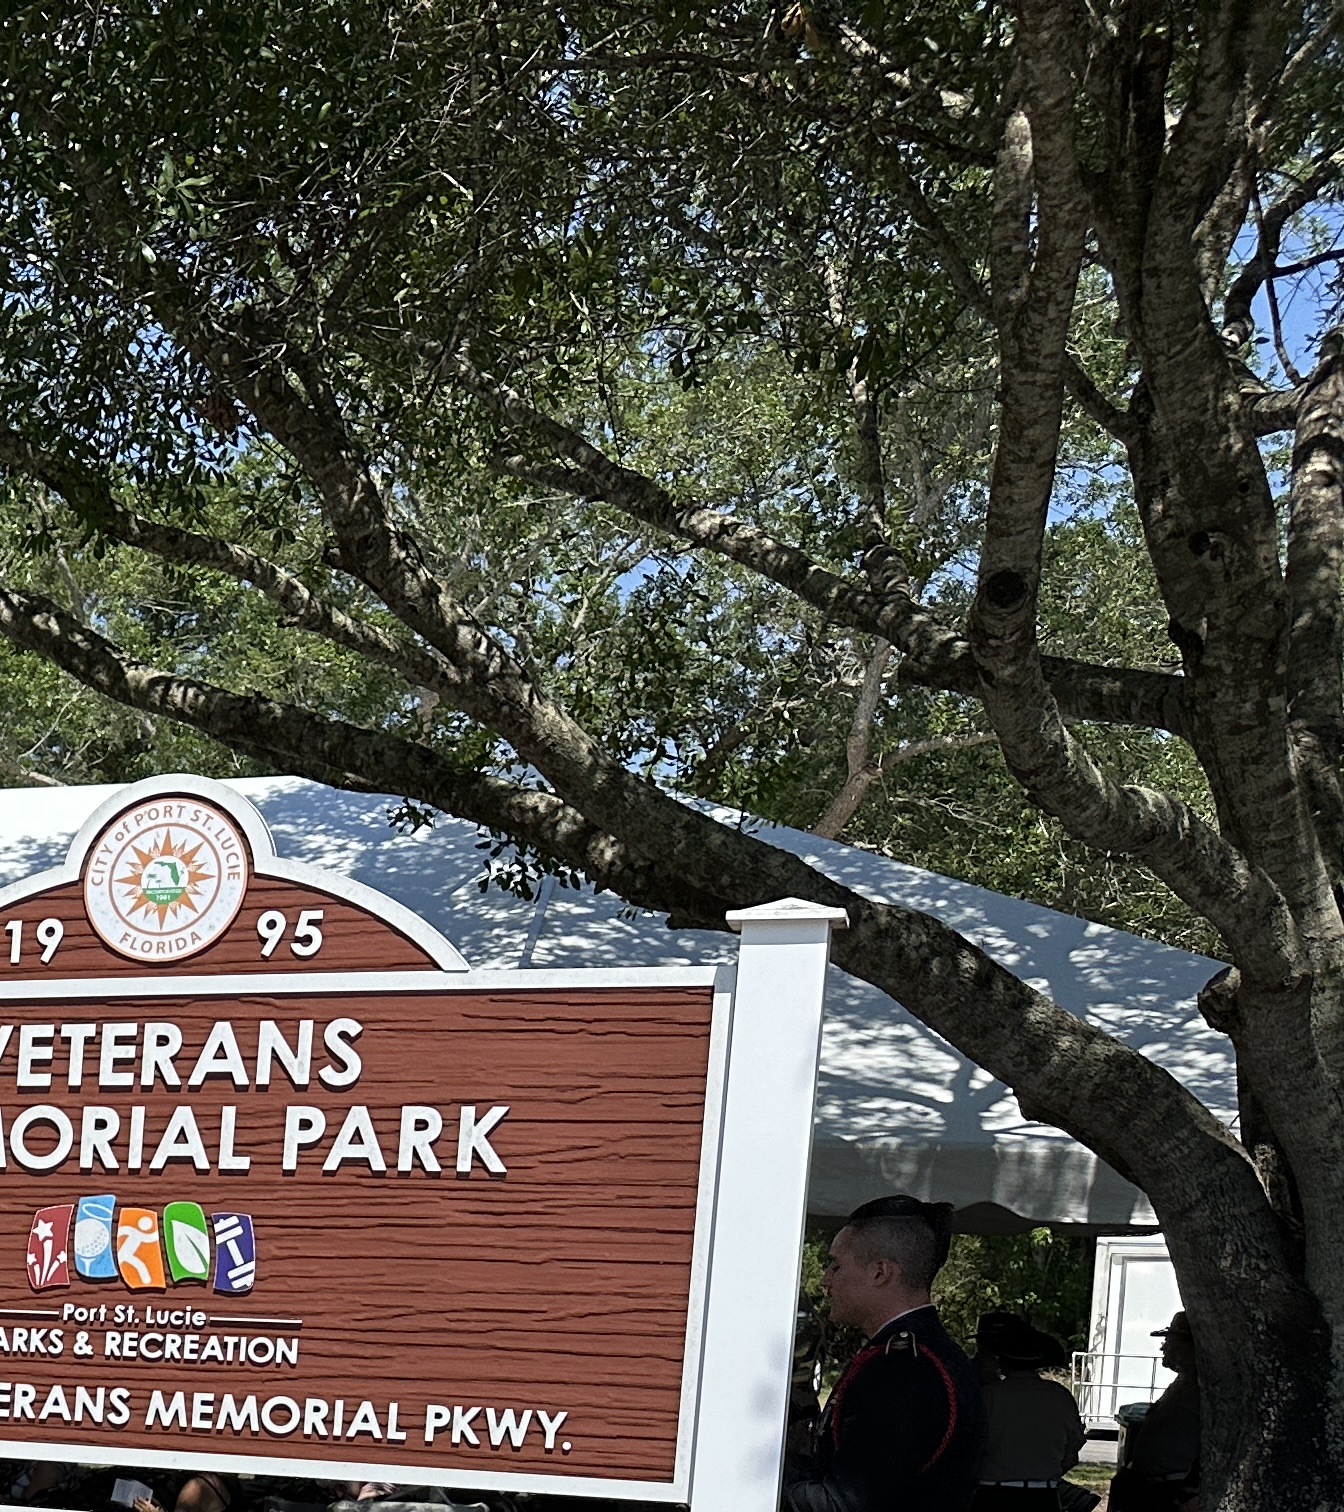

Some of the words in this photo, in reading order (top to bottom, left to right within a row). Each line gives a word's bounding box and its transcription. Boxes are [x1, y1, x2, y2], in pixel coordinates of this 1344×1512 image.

[91, 844, 114, 886] CITY
[115, 822, 131, 841] of
[134, 805, 186, 827] PORT
[190, 809, 214, 831] ST.
[214, 828, 241, 880] LUCIE
[4, 918, 64, 964] 19
[256, 909, 324, 959] 95
[119, 931, 202, 954] FLORIDA
[282, 1105, 511, 1175] PARK
[63, 1304, 107, 1322] Port
[114, 1305, 140, 1325] St.
[146, 1306, 206, 1327] Lucie
[73, 1332, 94, 1356] &
[105, 1331, 299, 1365] RECREATION
[145, 1390, 406, 1443] MEMORIAL
[424, 1405, 573, 1452] PKWY.
